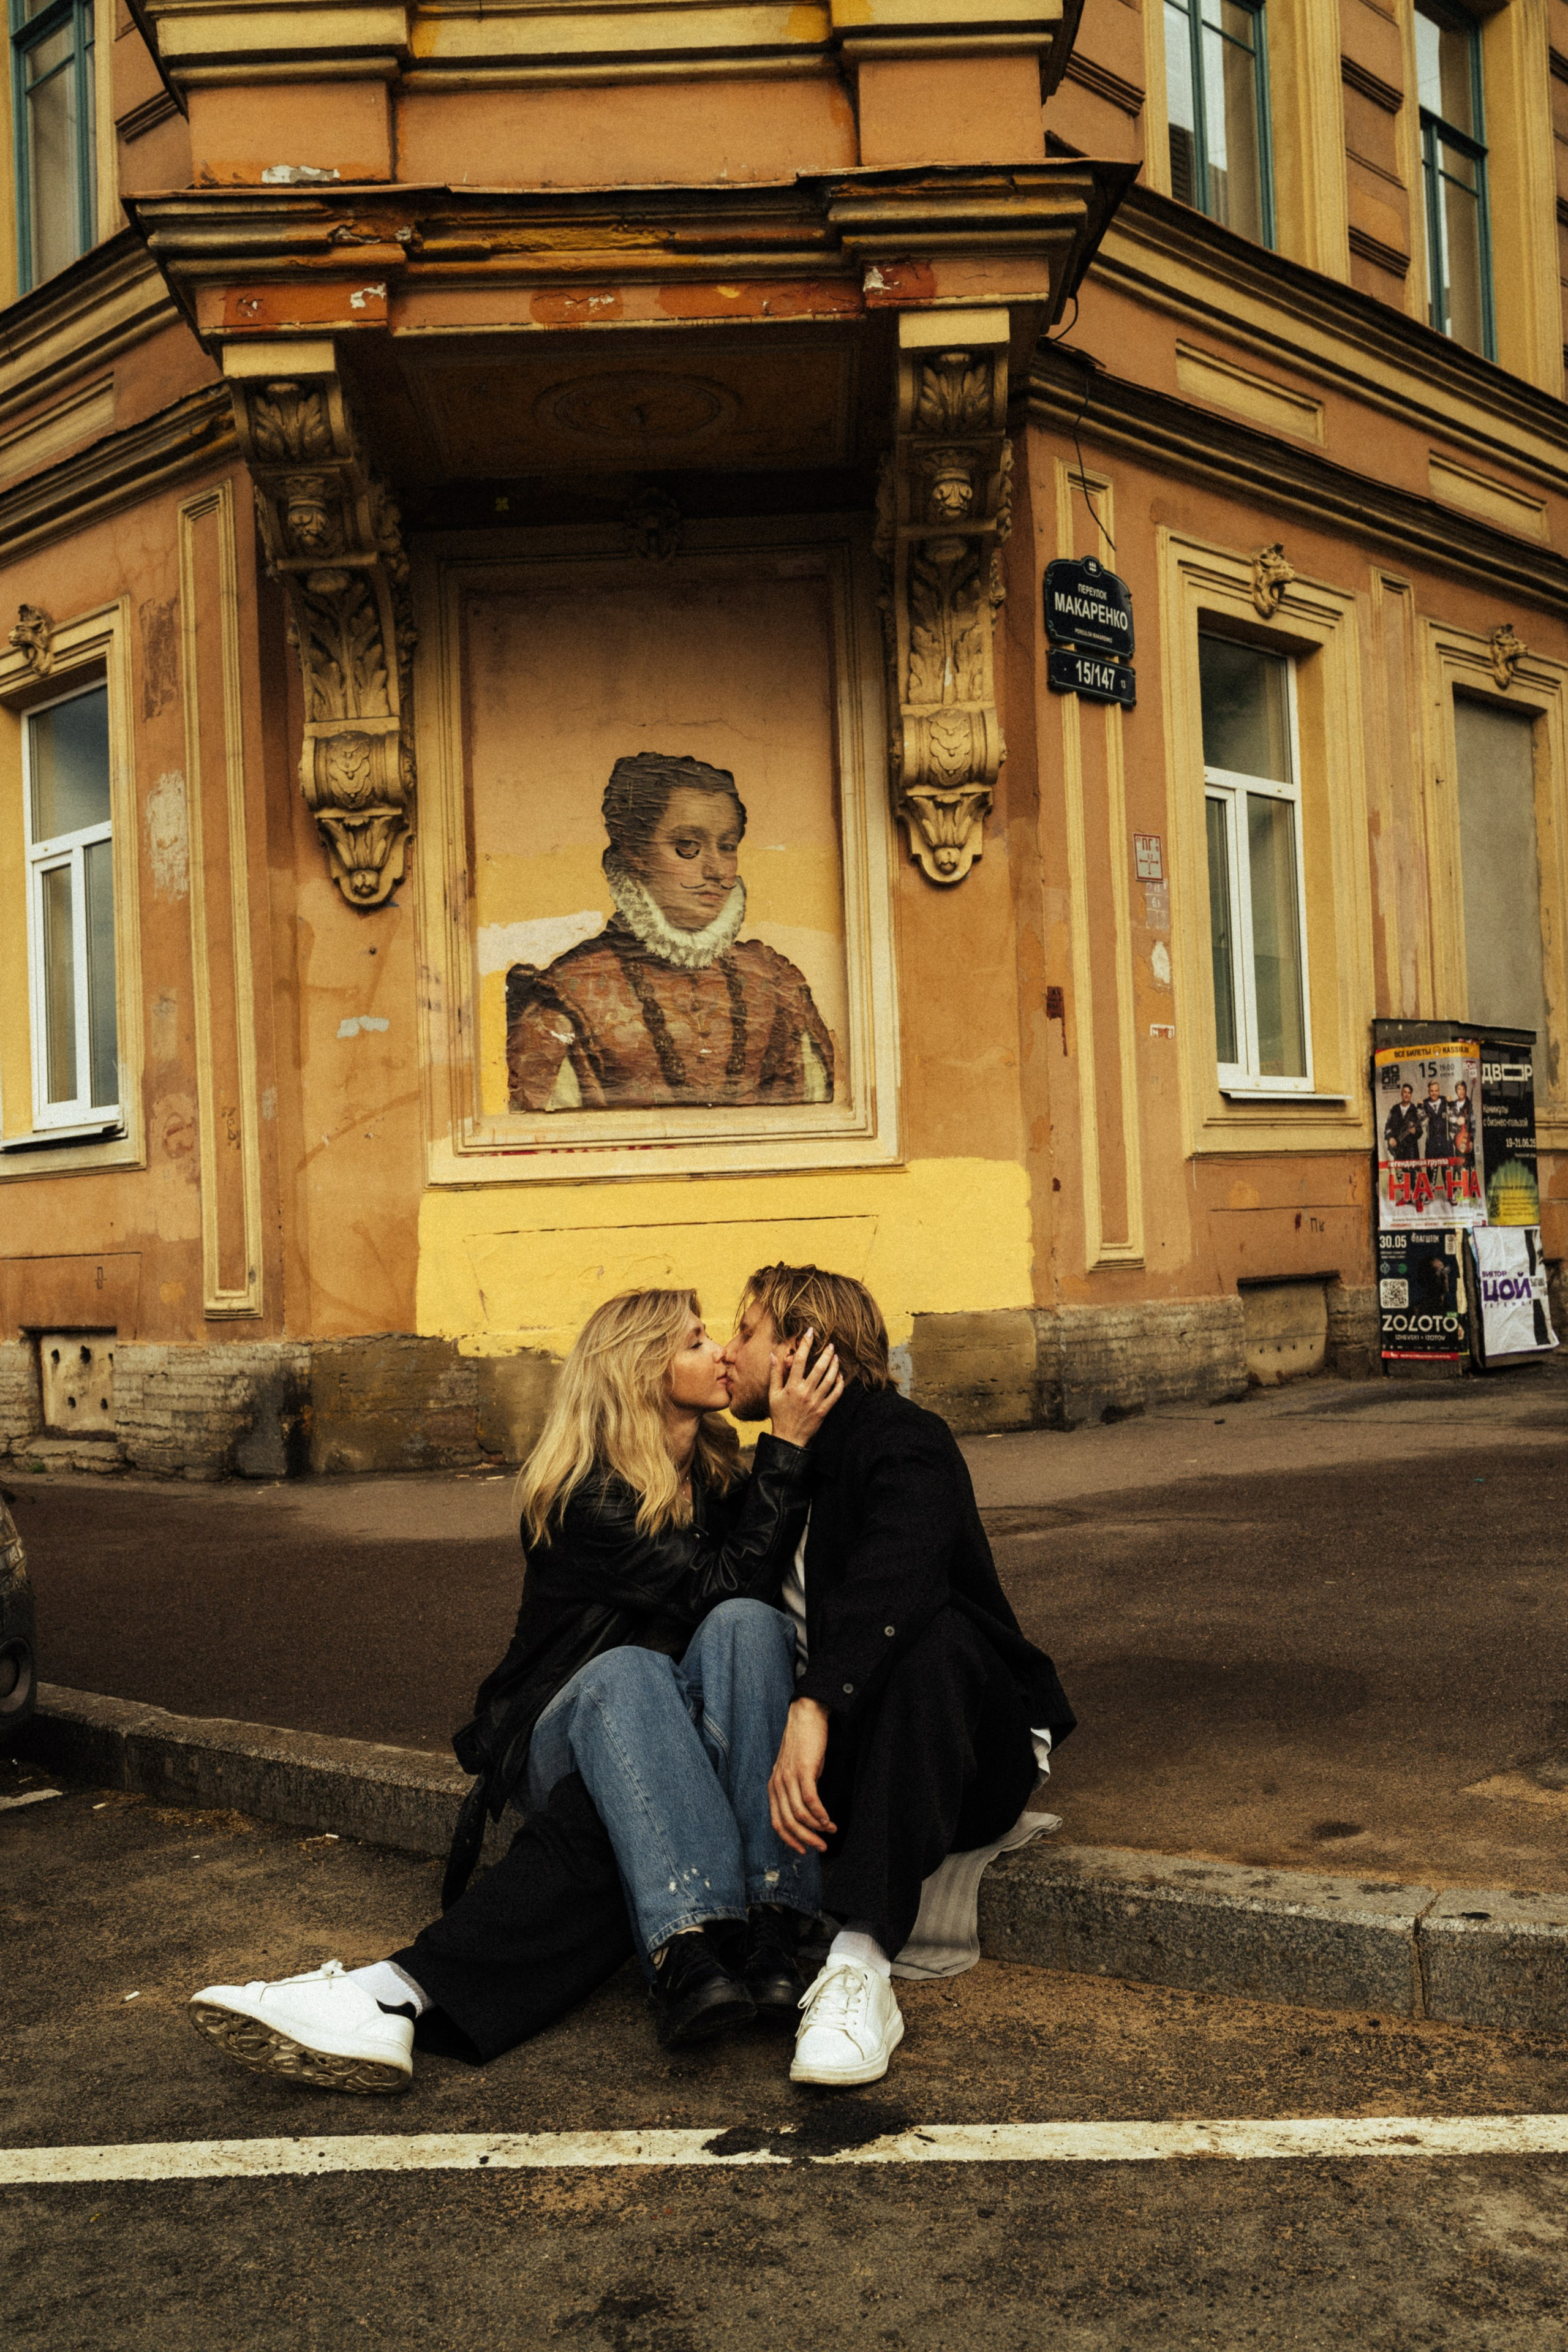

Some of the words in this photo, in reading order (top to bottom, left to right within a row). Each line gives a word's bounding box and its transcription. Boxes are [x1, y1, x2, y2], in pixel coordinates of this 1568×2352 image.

[1078, 583, 1107, 601] ПЕРЕУЛОК
[1054, 592, 1128, 631] МАКАРЕНКО
[1076, 660, 1115, 690] 15/147
[1142, 837, 1153, 851] ПГ
[1406, 1049, 1431, 1057] БИЛЕТЫ
[1419, 1061, 1438, 1078] 15
[1482, 1063, 1532, 1084] ДВОР
[1389, 1169, 1482, 1200] НА-НА
[1379, 1235, 1407, 1248] 30.05
[1483, 1272, 1531, 1302] ЦОЙ
[1382, 1314, 1458, 1332] ZOLOTO
